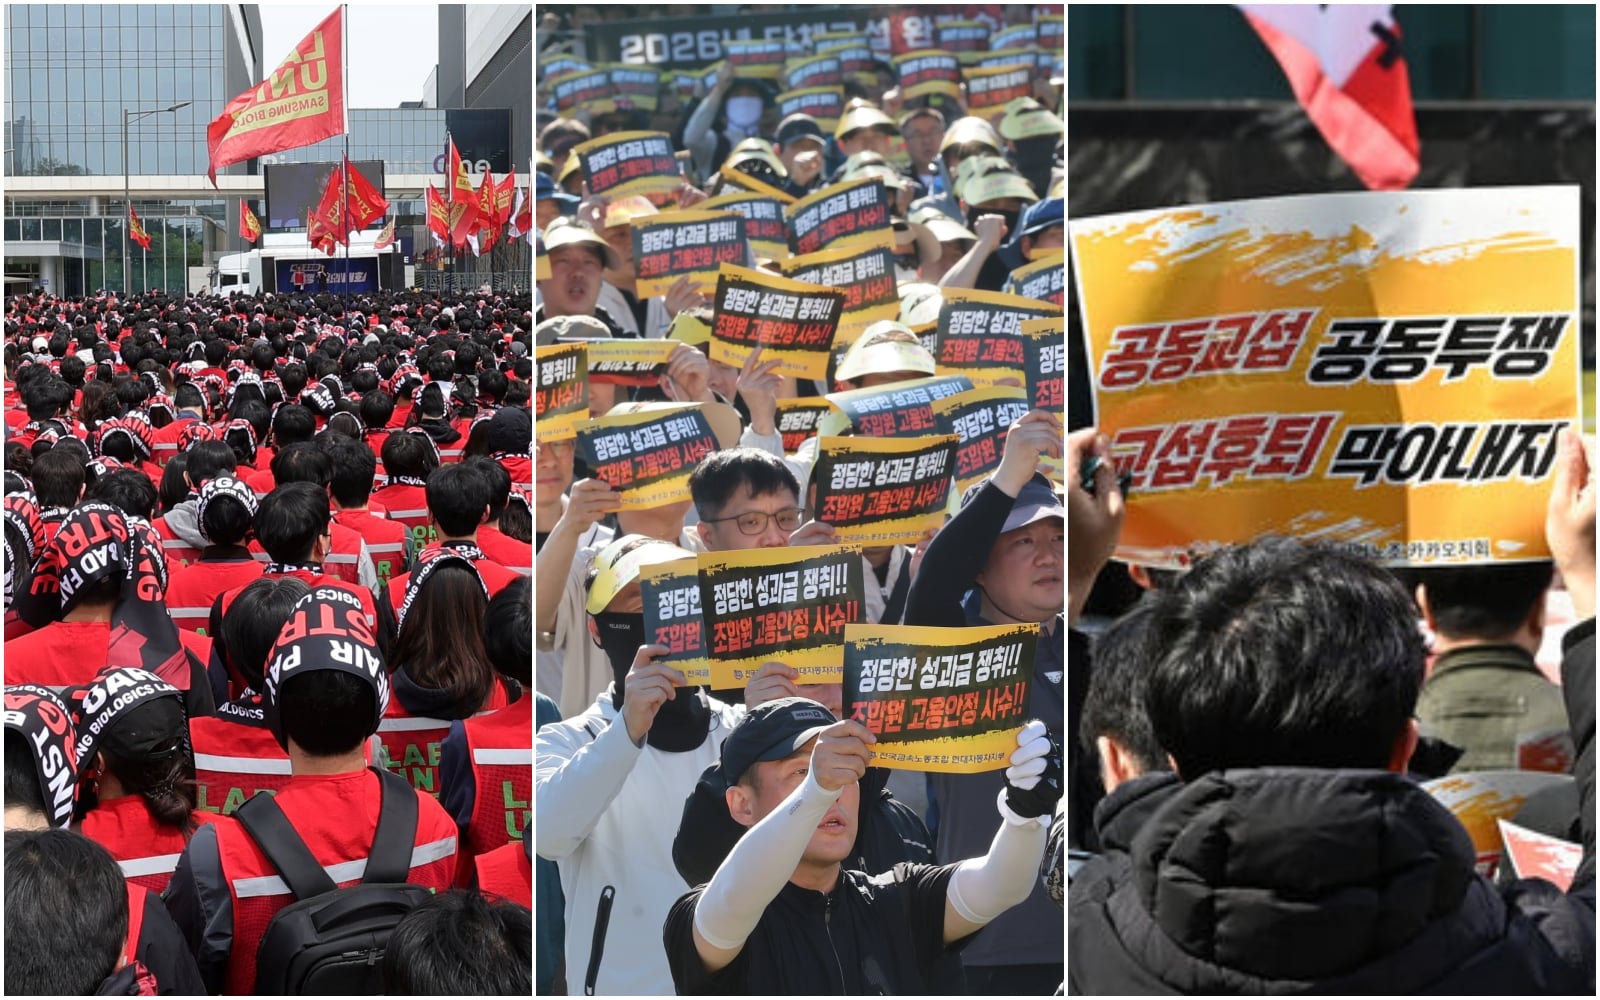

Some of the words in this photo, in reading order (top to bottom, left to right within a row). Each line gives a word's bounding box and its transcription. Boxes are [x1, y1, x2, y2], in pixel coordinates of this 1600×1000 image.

[855, 253, 886, 280] 쟁취!!
[723, 287, 759, 314] 정당한
[758, 293, 800, 320] 성과금
[798, 296, 835, 321] 쟁취!!
[864, 276, 893, 301] 사수!!
[715, 313, 749, 340] 조합원
[748, 317, 799, 344] 고용안정
[796, 323, 833, 345] 사수!!
[949, 309, 990, 335] 정당한
[940, 338, 981, 362] 조합원
[1099, 310, 1316, 389] 공동교섭
[1307, 314, 1571, 384] 공동투쟁
[541, 356, 577, 386] 쟁취!!
[549, 381, 584, 410] 사수!!
[593, 432, 632, 462] 정당한
[630, 423, 667, 452] 성과금
[664, 415, 701, 442] 쟁취!!
[634, 446, 682, 480] 고용안정
[830, 461, 875, 490] 정당한
[874, 456, 915, 486] 성과금
[914, 448, 949, 481] 쟁취!!
[821, 492, 865, 521] 조합원
[864, 485, 917, 516] 고용안정
[913, 477, 948, 509] 사수!!
[80, 541, 119, 574] BAD
[1409, 540, 1490, 558] 카카오지회
[713, 577, 754, 615] 정당한
[755, 570, 799, 607] 성과금
[802, 562, 848, 600] 쟁취!!
[713, 616, 753, 653] 조합원
[754, 607, 810, 645] 고용안정
[813, 599, 860, 636] 사수!!
[858, 656, 917, 693] 정당한
[919, 651, 974, 690] 성과금
[975, 642, 1023, 682] 쟁취!!
[89, 684, 155, 735] BIOLOGICS
[906, 690, 980, 730] 고용안정
[980, 680, 1027, 721] 사수!!
